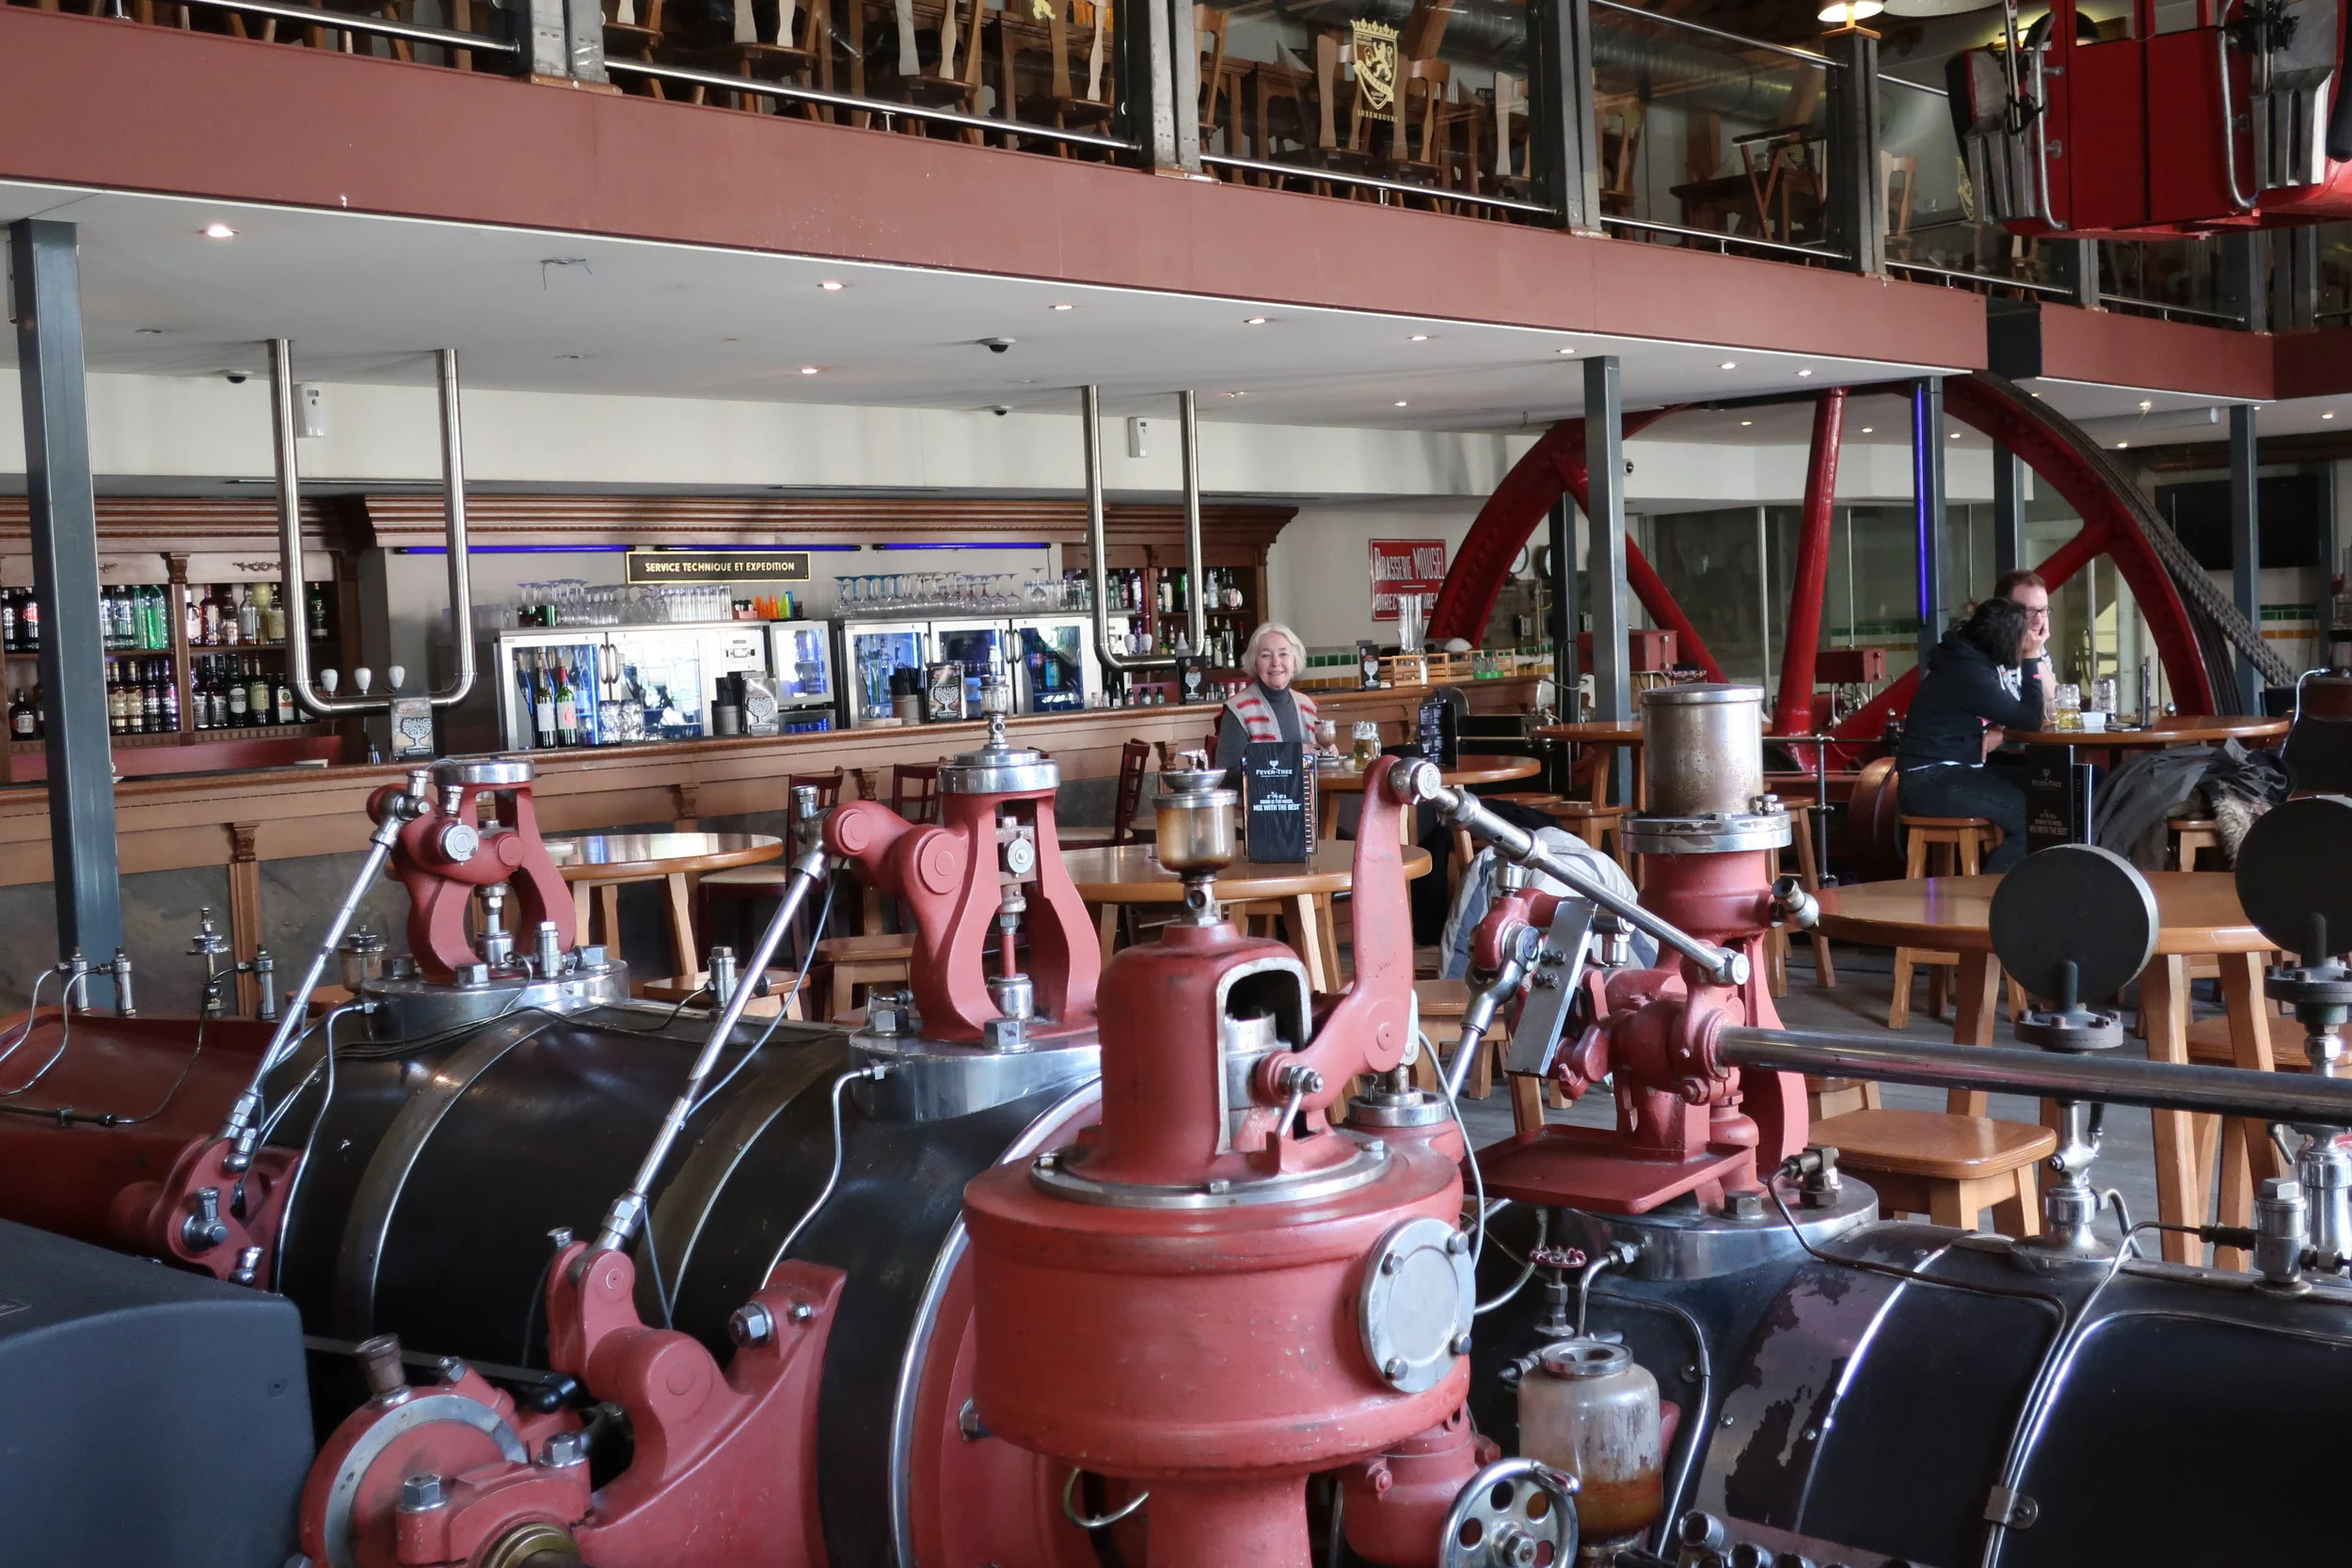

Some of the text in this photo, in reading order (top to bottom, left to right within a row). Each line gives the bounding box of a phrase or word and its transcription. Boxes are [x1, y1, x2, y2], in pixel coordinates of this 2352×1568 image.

[1358, 109, 1398, 122] LUXEMBOURG
[645, 562, 795, 572] SERVICE TECHNIQUE ET EXPEDITION
[1374, 547, 1445, 580] BRASSERIE MOUSEL
